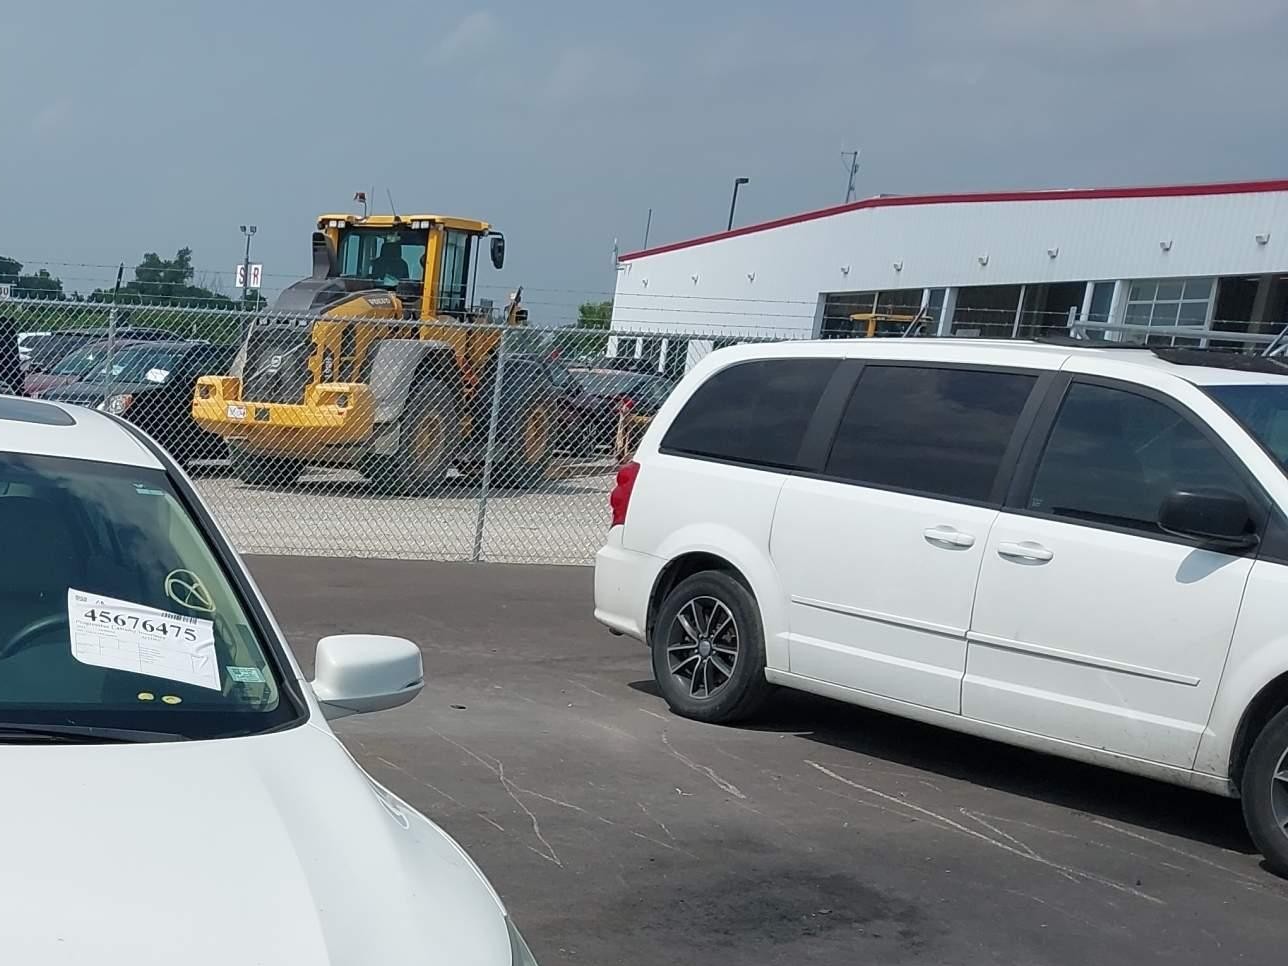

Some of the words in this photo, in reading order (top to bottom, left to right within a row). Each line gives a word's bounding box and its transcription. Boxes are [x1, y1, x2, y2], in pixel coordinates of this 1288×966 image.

[238, 266, 246, 285] S
[252, 266, 260, 286] R
[83, 608, 198, 642] 45676475
